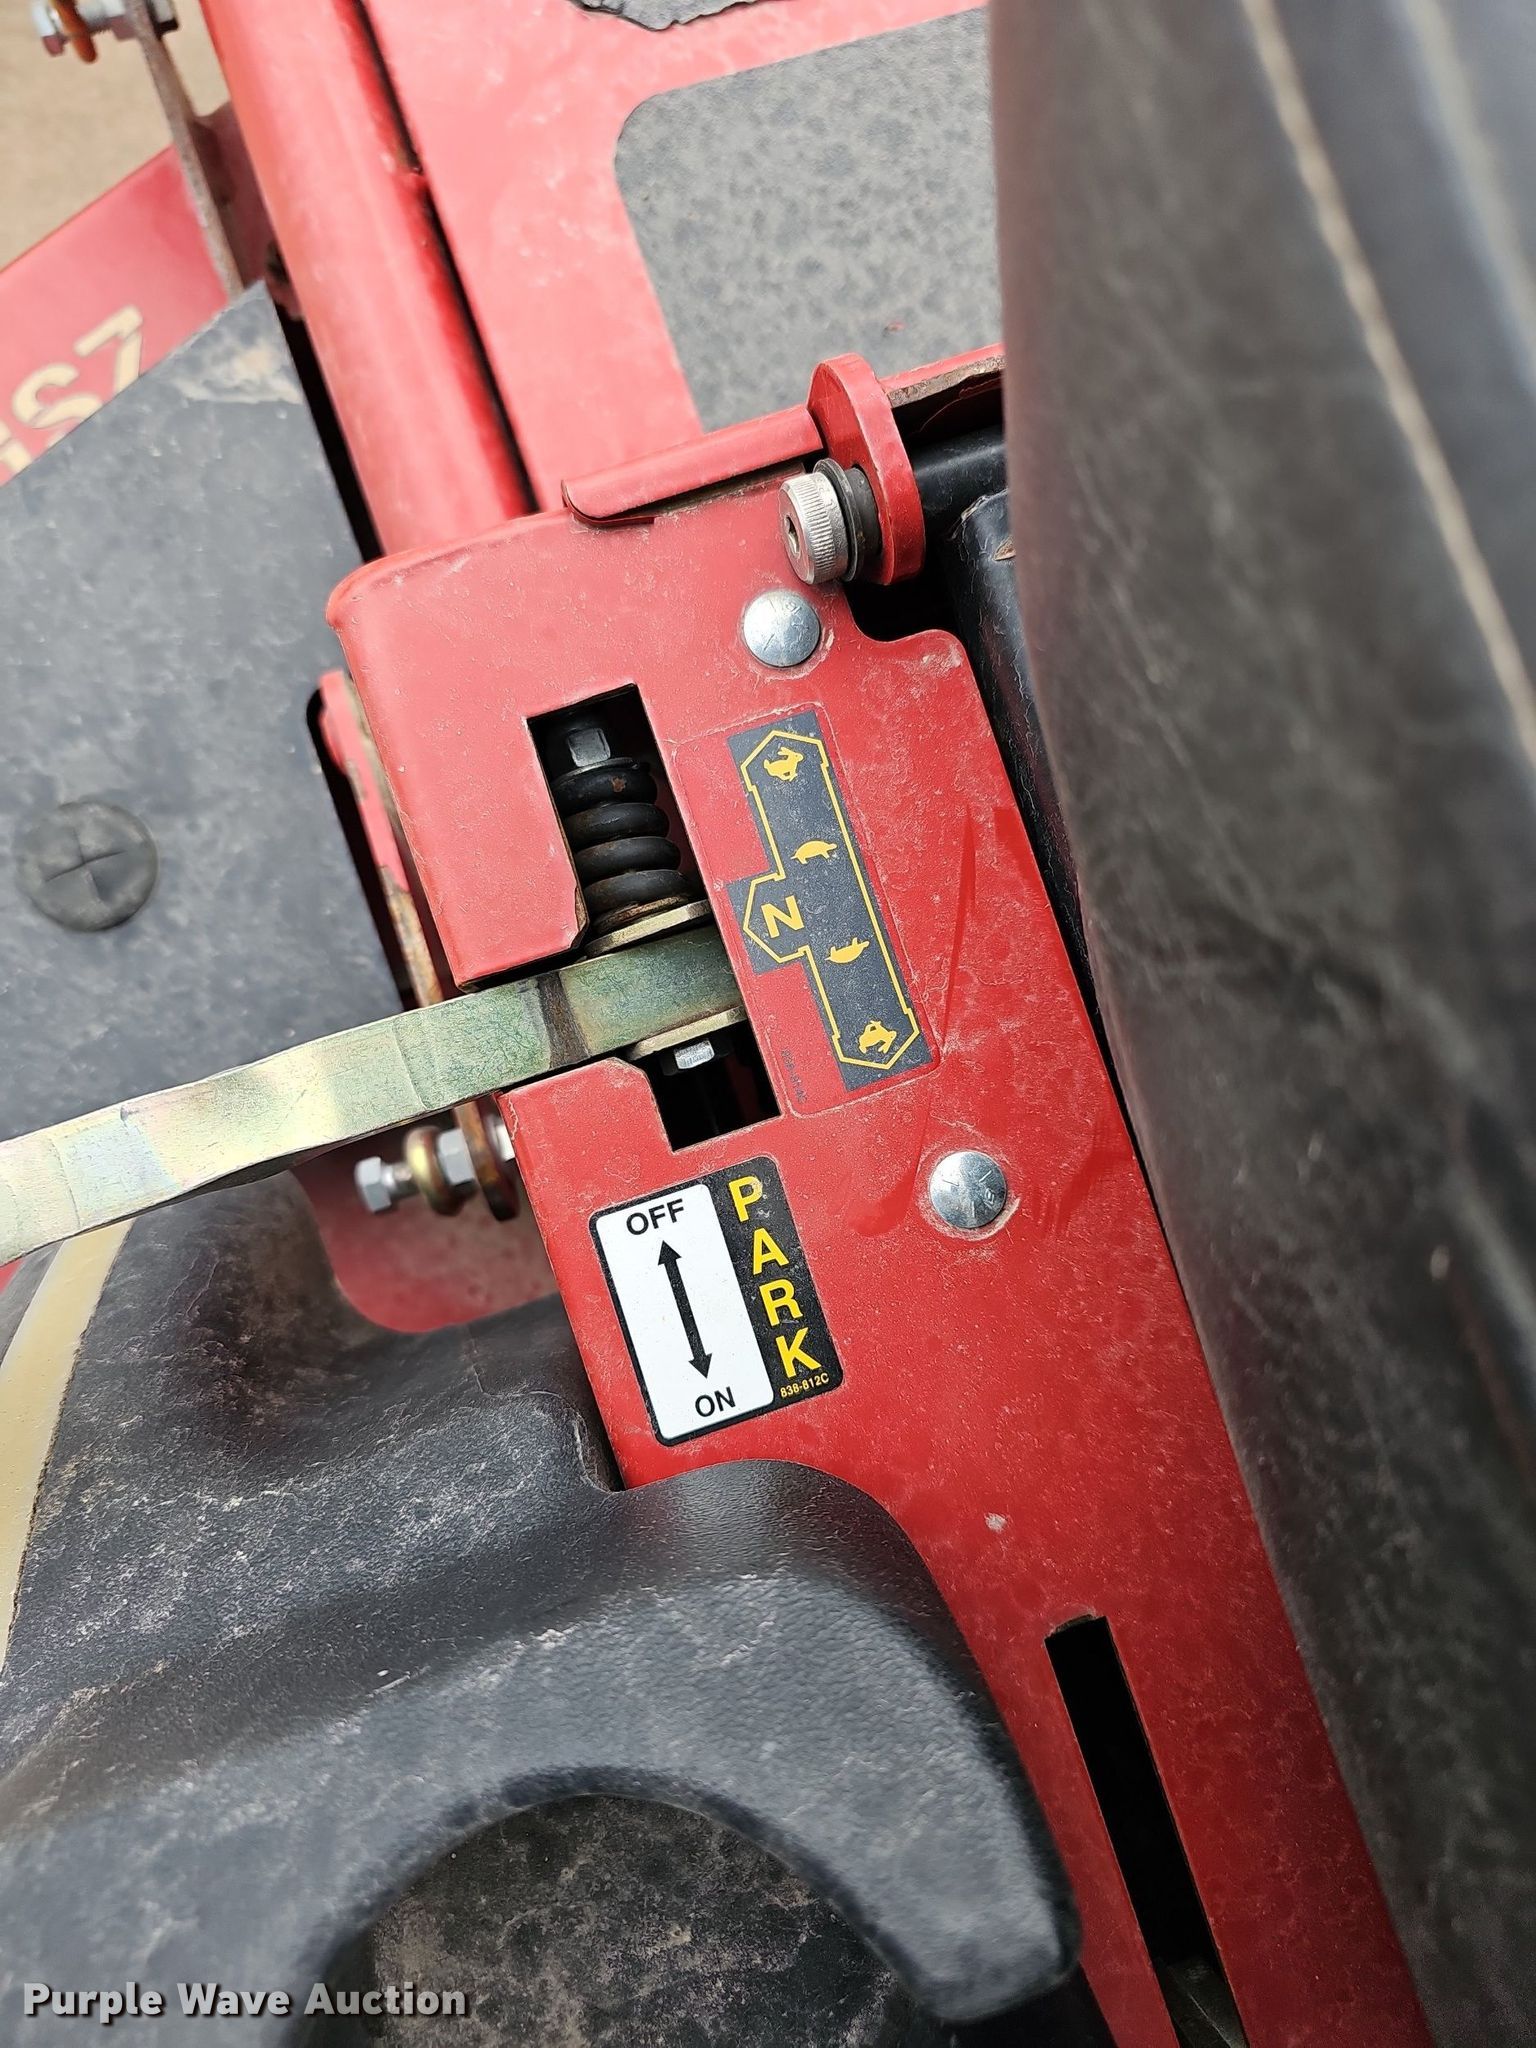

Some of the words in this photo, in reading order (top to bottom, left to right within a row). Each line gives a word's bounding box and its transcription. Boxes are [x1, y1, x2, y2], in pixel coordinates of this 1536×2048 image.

[760, 895, 805, 938] N
[626, 1199, 684, 1235] OFF
[728, 1175, 821, 1378] PARK
[694, 1386, 736, 1417] ON
[780, 1372, 830, 1398] 838-812C
